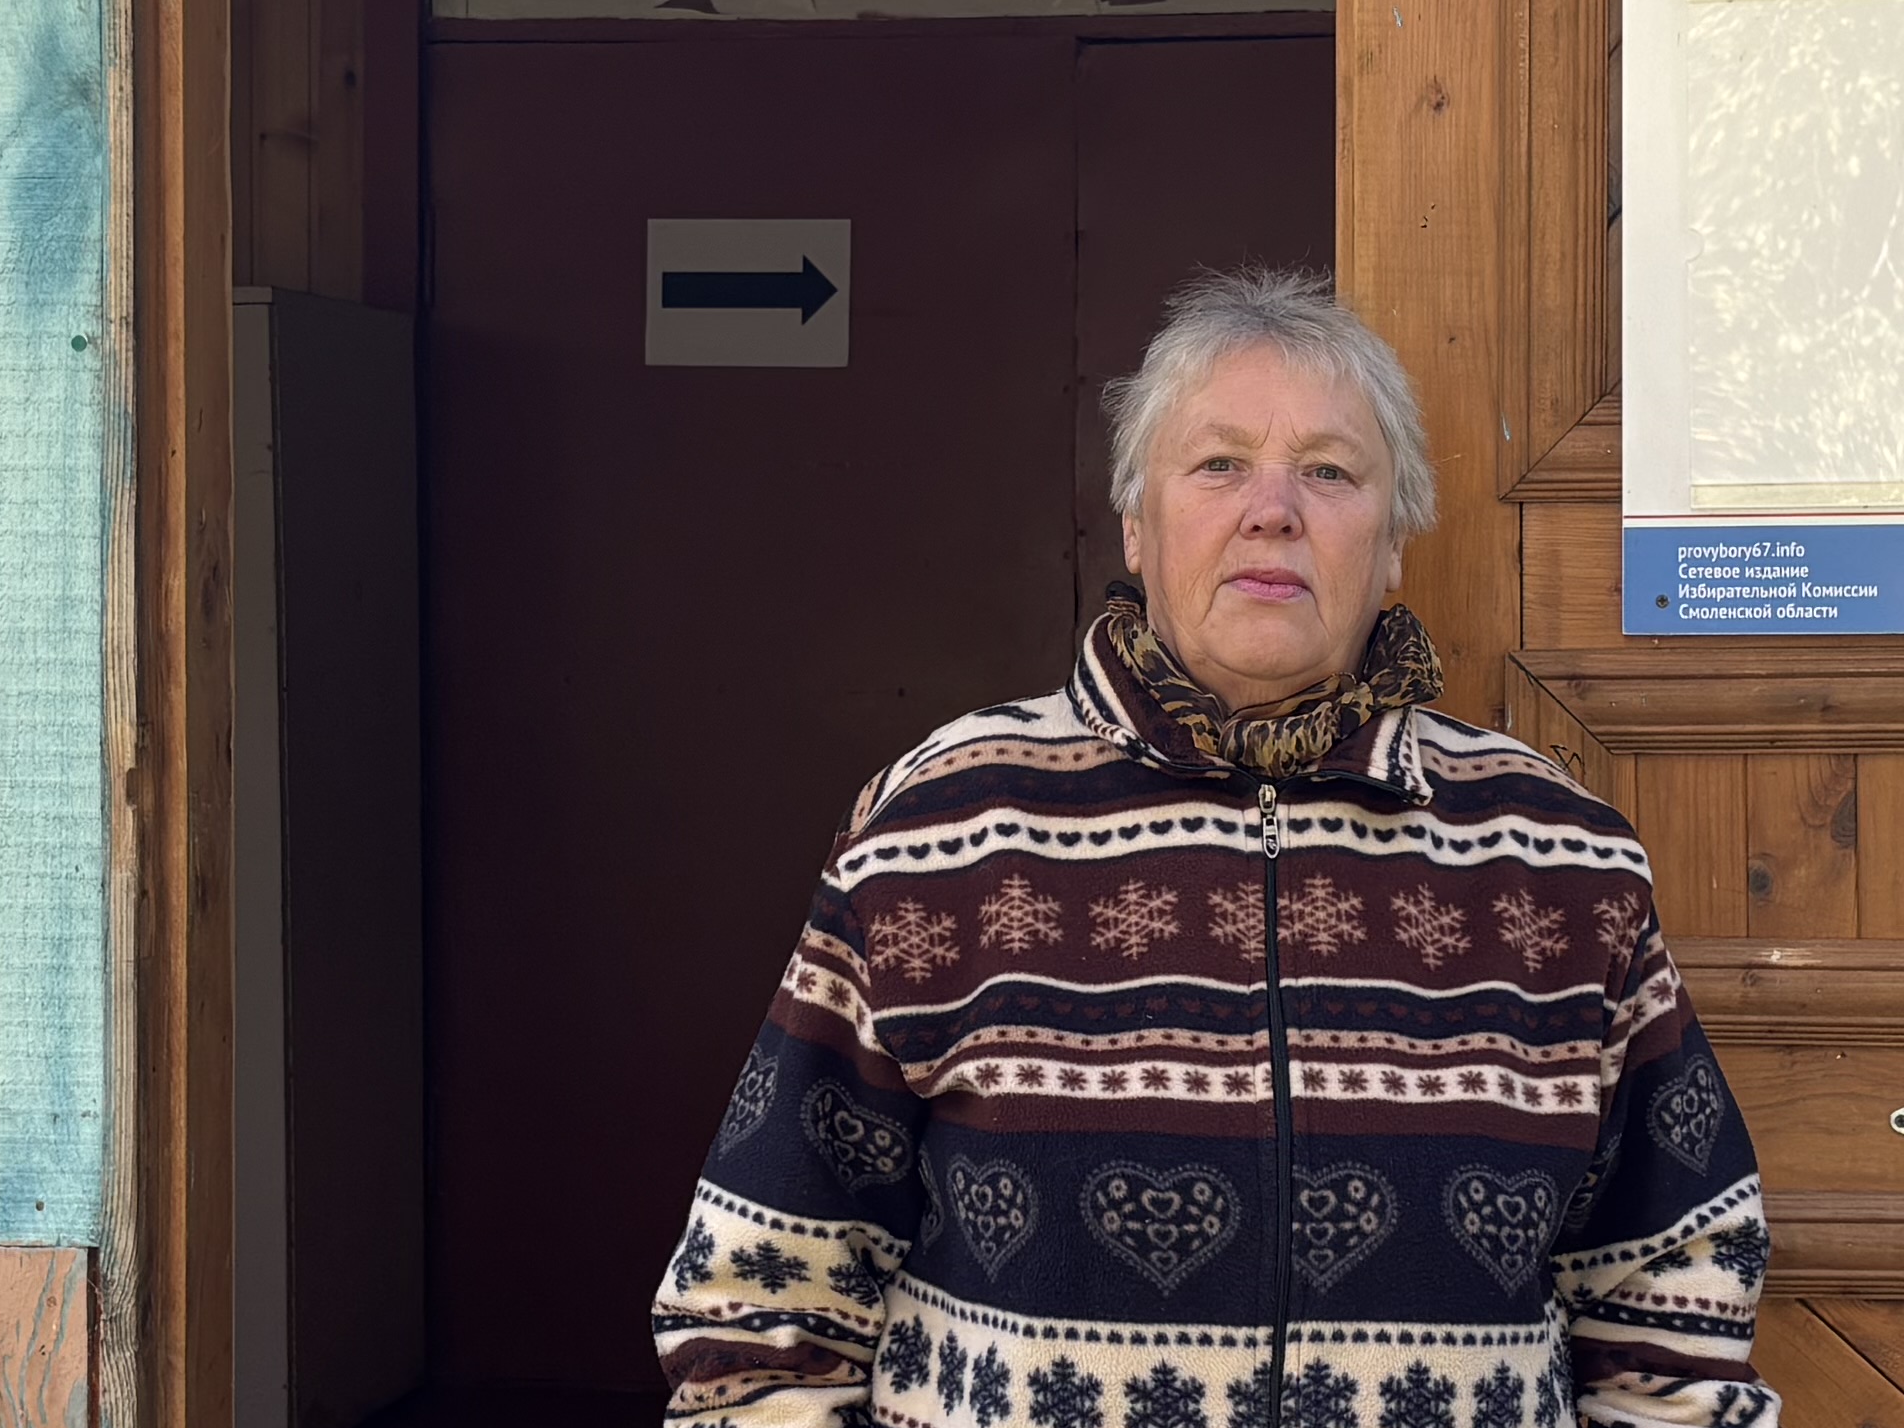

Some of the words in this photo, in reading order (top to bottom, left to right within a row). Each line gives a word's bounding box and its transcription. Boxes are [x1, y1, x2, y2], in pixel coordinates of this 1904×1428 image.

[1678, 543, 1805, 562] provybory67.info
[1679, 563, 1740, 578] Сетевое
[1745, 565, 1809, 580] издание
[1679, 583, 1796, 602] Избирательной
[1802, 583, 1878, 598] Комиссии
[1679, 604, 1771, 619] Смоленской
[1776, 604, 1838, 618] области
